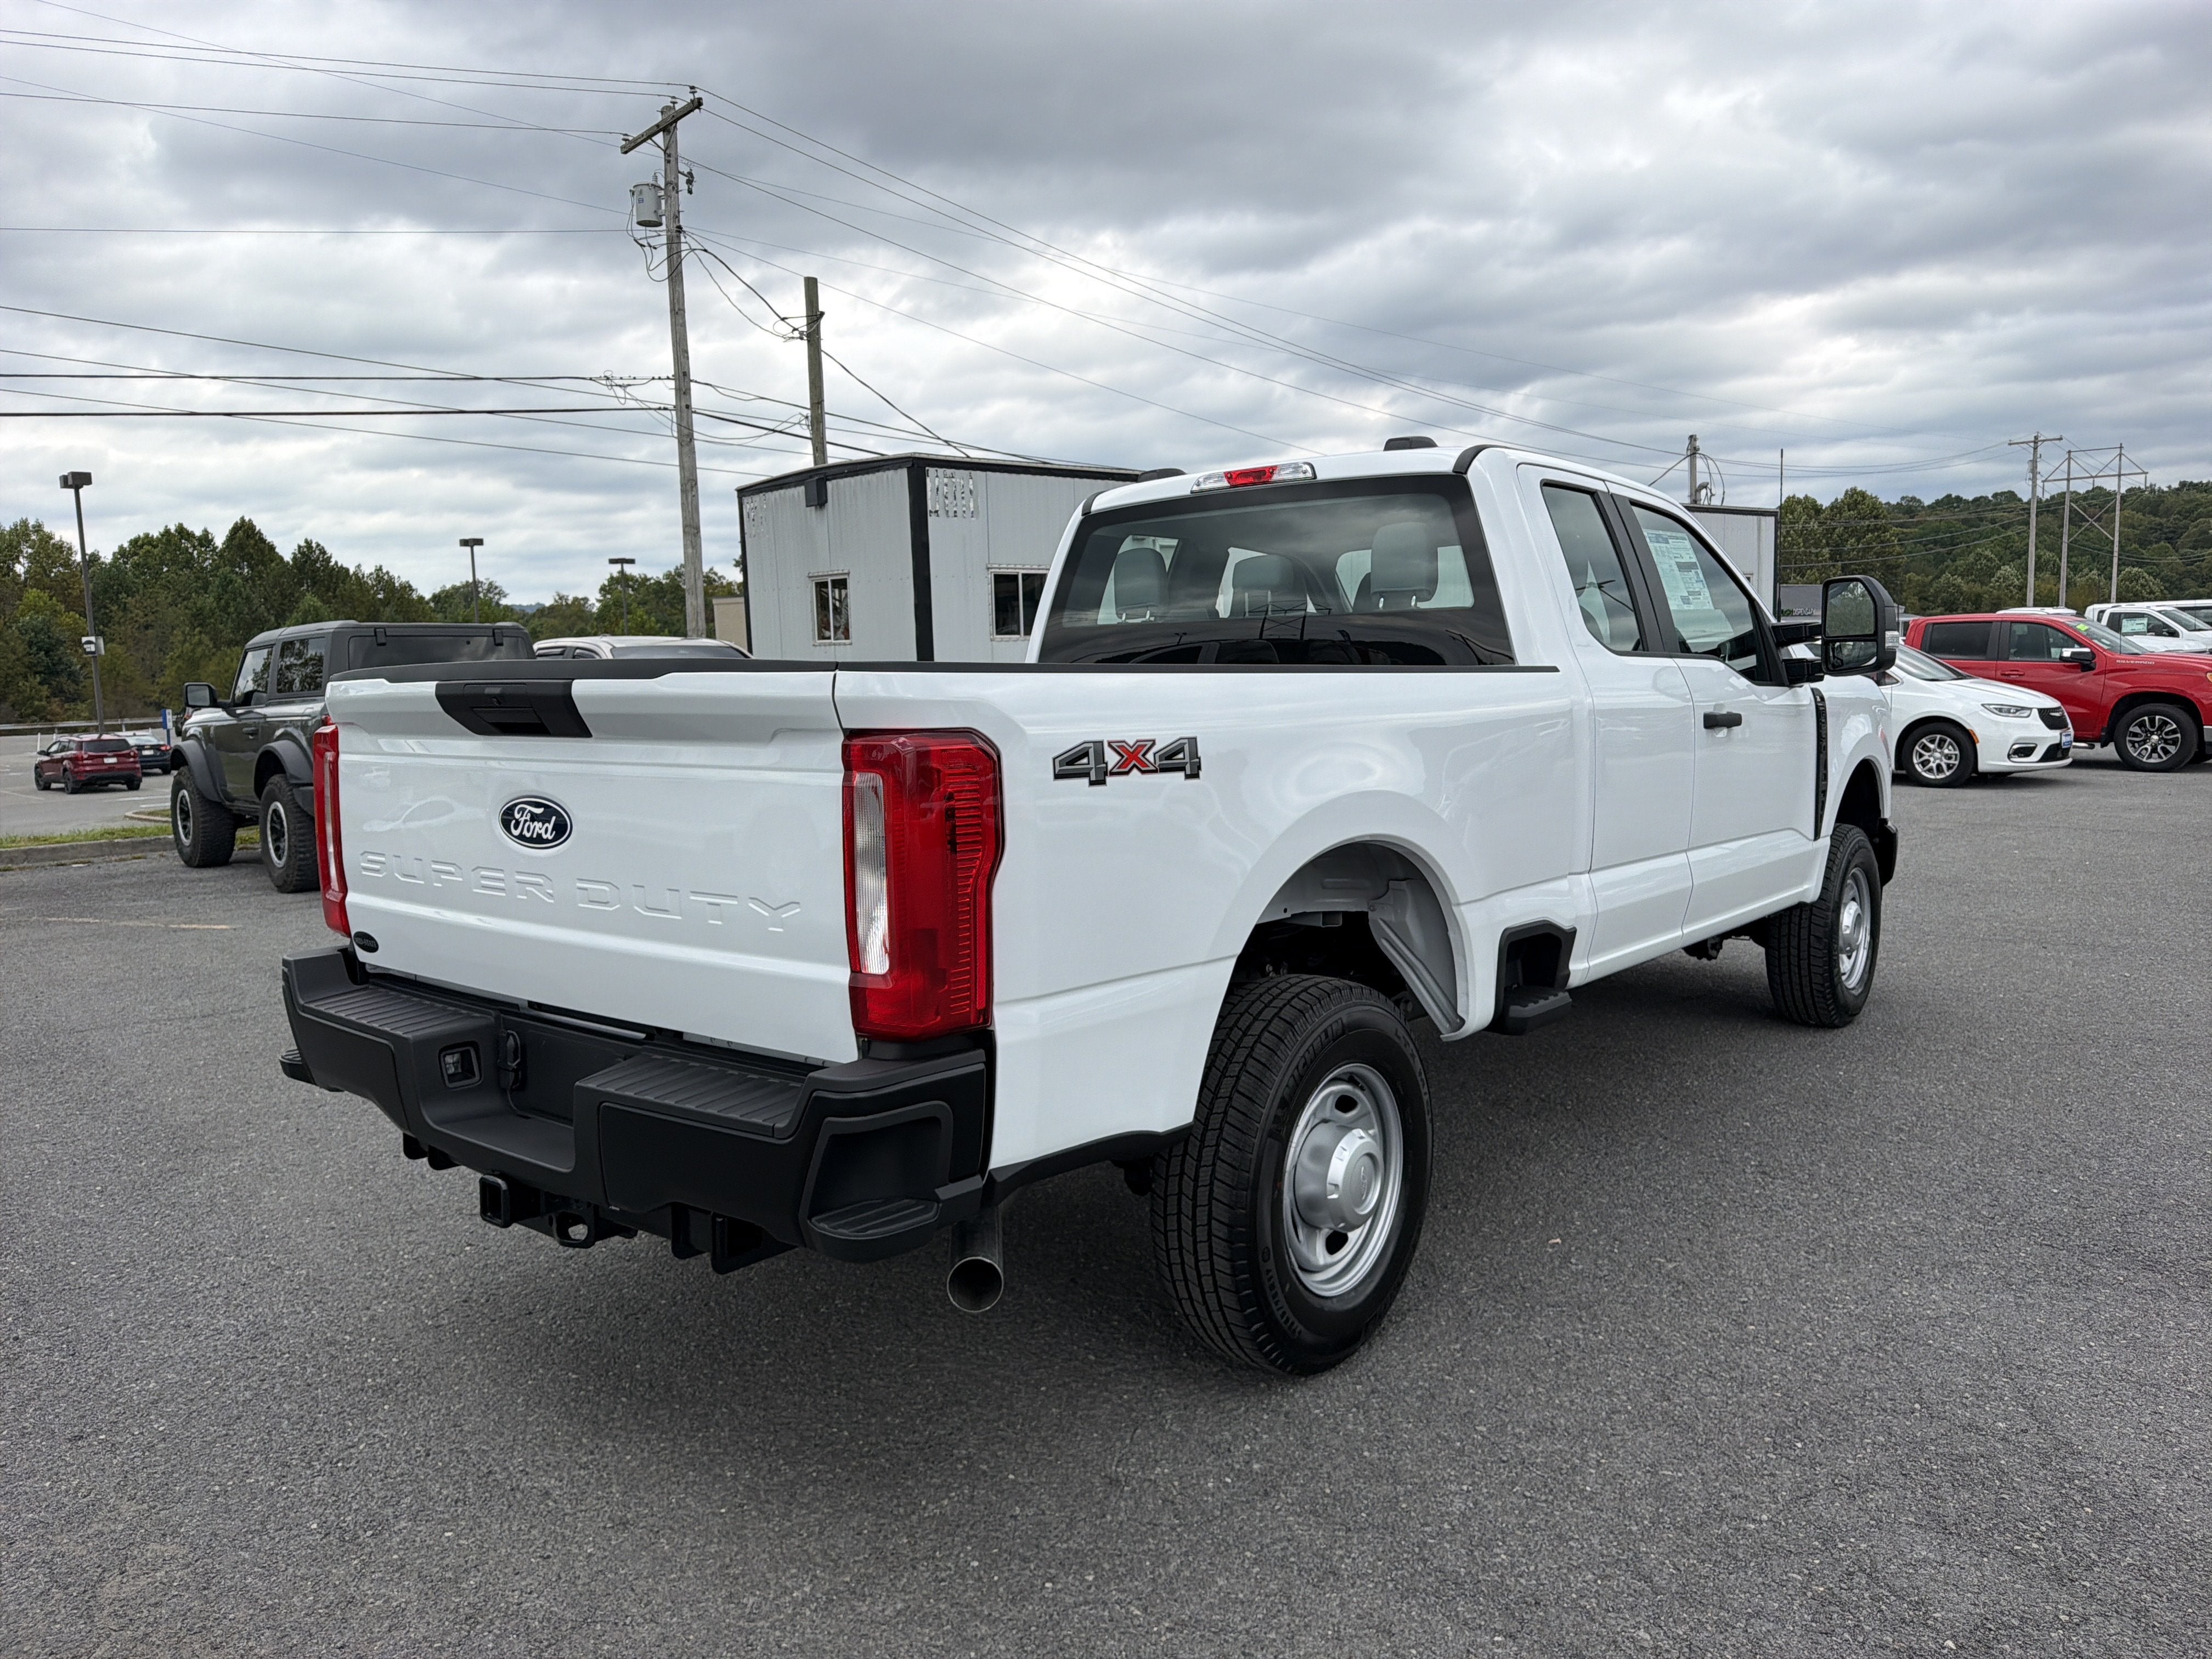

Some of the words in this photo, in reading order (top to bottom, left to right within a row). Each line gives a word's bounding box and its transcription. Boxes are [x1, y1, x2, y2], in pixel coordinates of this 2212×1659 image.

[510, 804, 556, 840] Ford
[360, 851, 554, 903] SUPER
[576, 878, 801, 932] DUTY
[1283, 1017, 1344, 1104] MICHELIN
